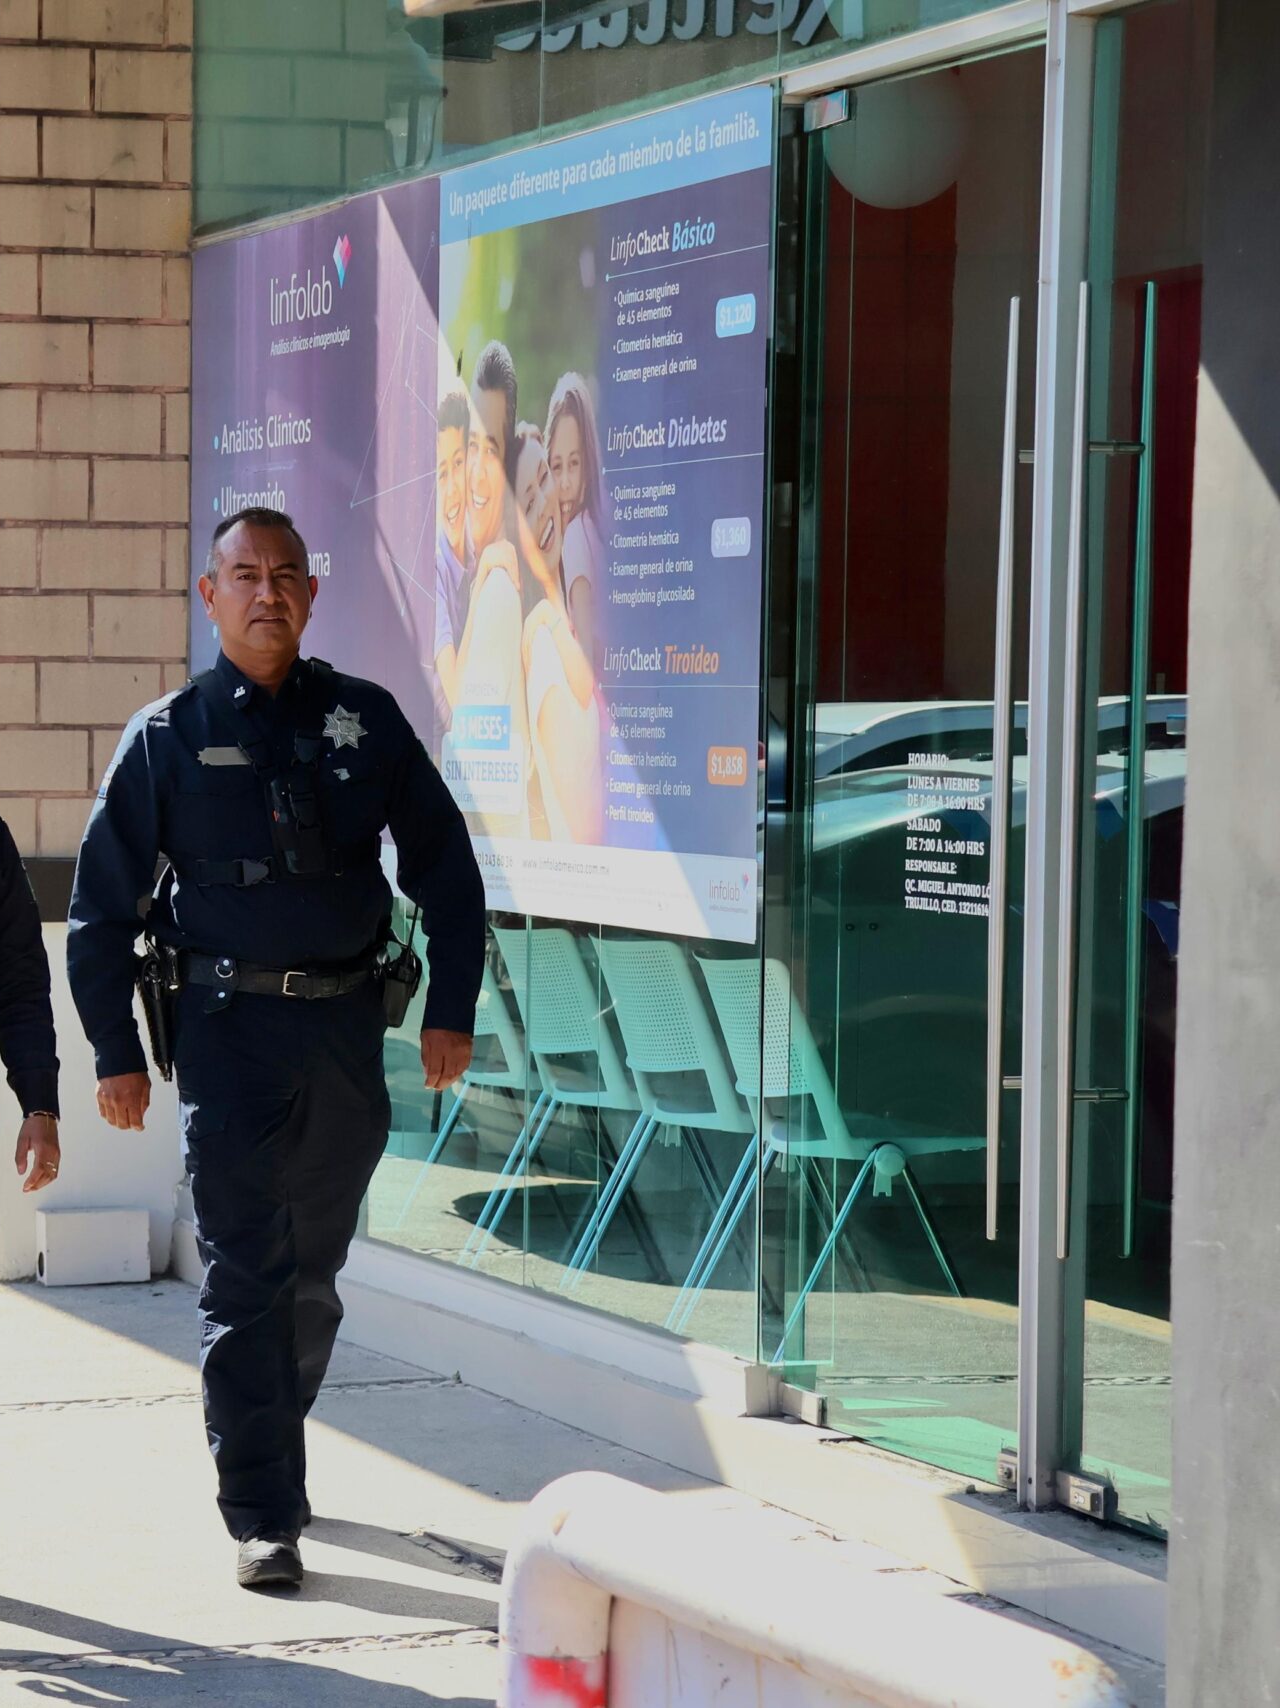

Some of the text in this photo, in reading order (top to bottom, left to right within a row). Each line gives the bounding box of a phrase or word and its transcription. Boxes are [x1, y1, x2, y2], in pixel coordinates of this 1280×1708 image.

[449, 111, 760, 220] Un paquete diferente para cada miembro de la familia.
[610, 216, 716, 266] LinfoCheck Básico
[270, 266, 332, 326] linfolab
[617, 305, 672, 326] de 45 elementos
[652, 330, 683, 349] hemática
[615, 356, 697, 383] Examen general de orina
[221, 413, 312, 455] Análisis Clínicos
[607, 416, 728, 457] LinfoCheck Diabetes
[614, 503, 669, 521] de 45 elementos
[649, 529, 679, 545] hemática
[613, 556, 694, 580] Examen general de orina
[612, 587, 655, 608] Hemoglobina
[603, 644, 720, 678] LinfoCheck Tiroideo
[610, 723, 666, 740] de 45 elementos
[645, 751, 677, 767] hemática
[711, 752, 743, 778] $1,858
[908, 753, 949, 768] HORARIO:
[445, 759, 519, 784] SIN INTERESES
[609, 777, 691, 798] Examen general de orina
[907, 775, 981, 793] LUNES A VIERNES
[907, 793, 919, 808] DE
[936, 795, 944, 809] A
[944, 795, 966, 810] 16:00
[966, 797, 985, 811] HRS
[609, 805, 654, 823] Perfil tiroideo
[906, 837, 985, 856] DE 7:00 A 14:00 HRS
[905, 859, 957, 875] RESPONSABLE:
[709, 879, 740, 902] linfolab
[905, 878, 917, 894] QC.
[917, 879, 946, 895] MIGUEL
[946, 881, 981, 898] ANTONIO
[905, 896, 941, 914] TRUJILLO,
[941, 900, 958, 914] CED.
